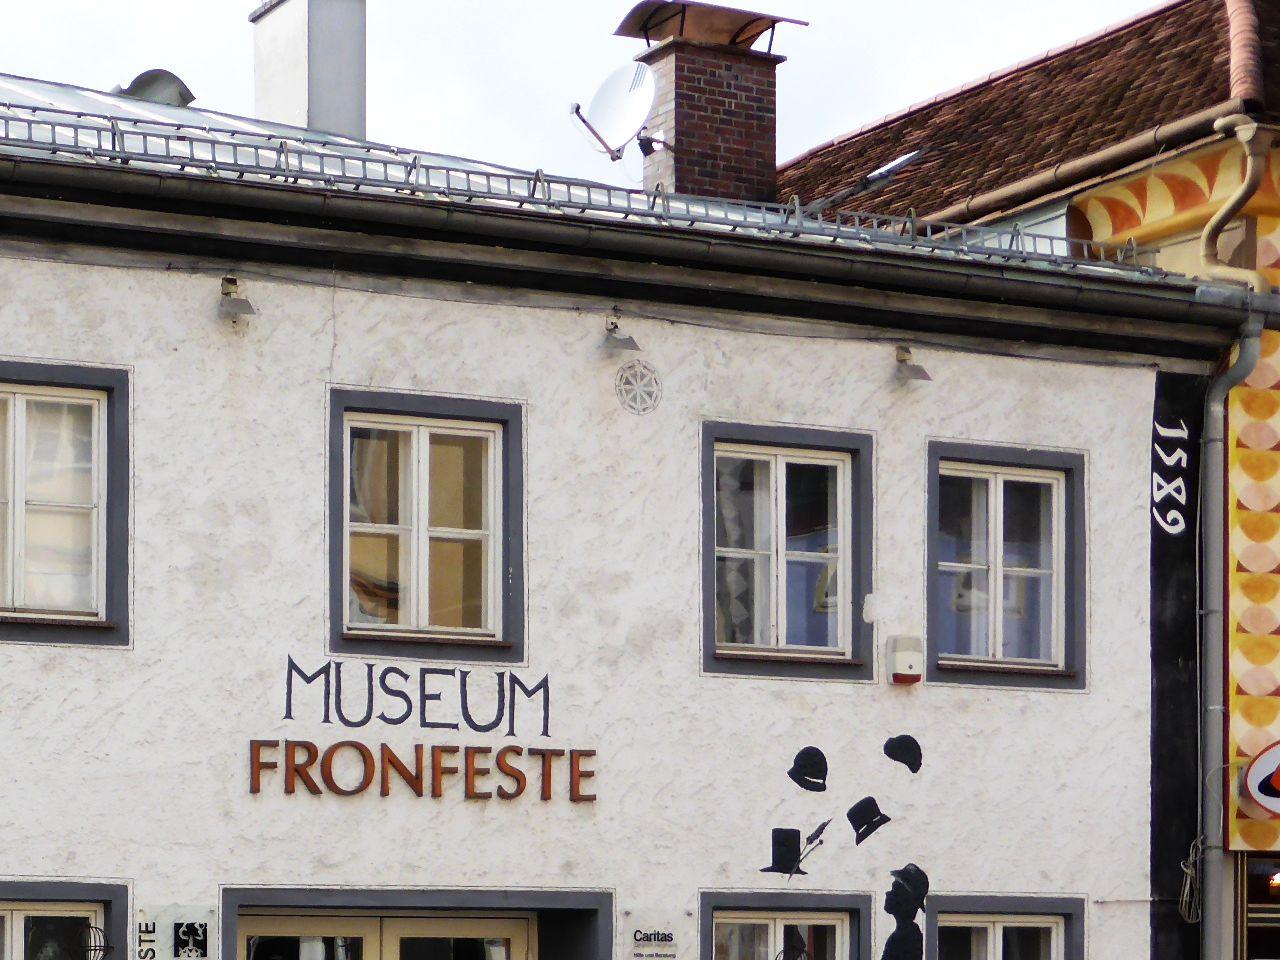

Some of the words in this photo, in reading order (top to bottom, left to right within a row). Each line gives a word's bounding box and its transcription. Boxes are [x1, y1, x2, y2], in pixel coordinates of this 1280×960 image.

[1152, 419, 1189, 534] 1589
[282, 653, 552, 738] MUSEUM
[248, 739, 598, 802] FRONFESTE
[633, 929, 674, 942] Caritas
